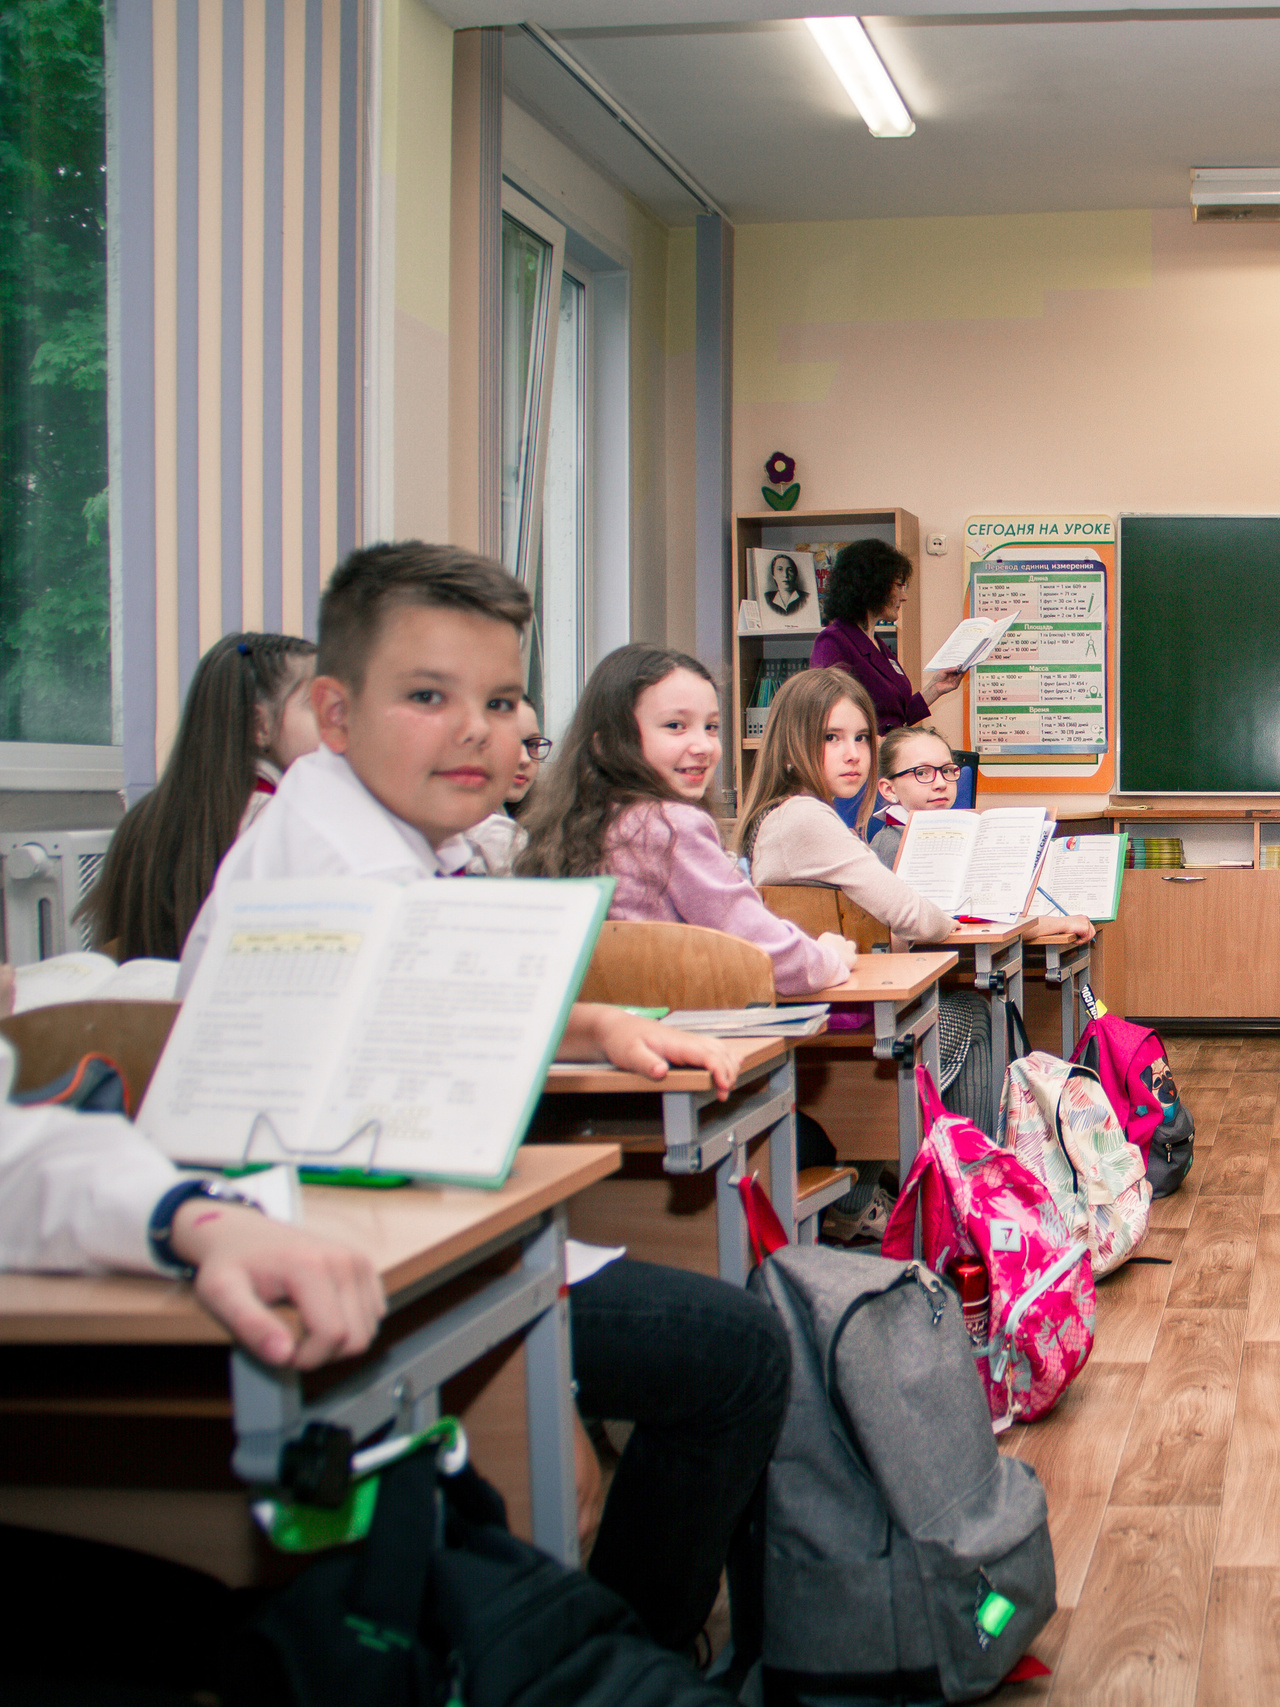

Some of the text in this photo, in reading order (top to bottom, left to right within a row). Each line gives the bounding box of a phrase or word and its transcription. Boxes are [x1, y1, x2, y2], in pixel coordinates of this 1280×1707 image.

[967, 523, 1111, 536] СЕГОДНЯ НА УРОКЕ
[985, 563, 1018, 571] Перевод
